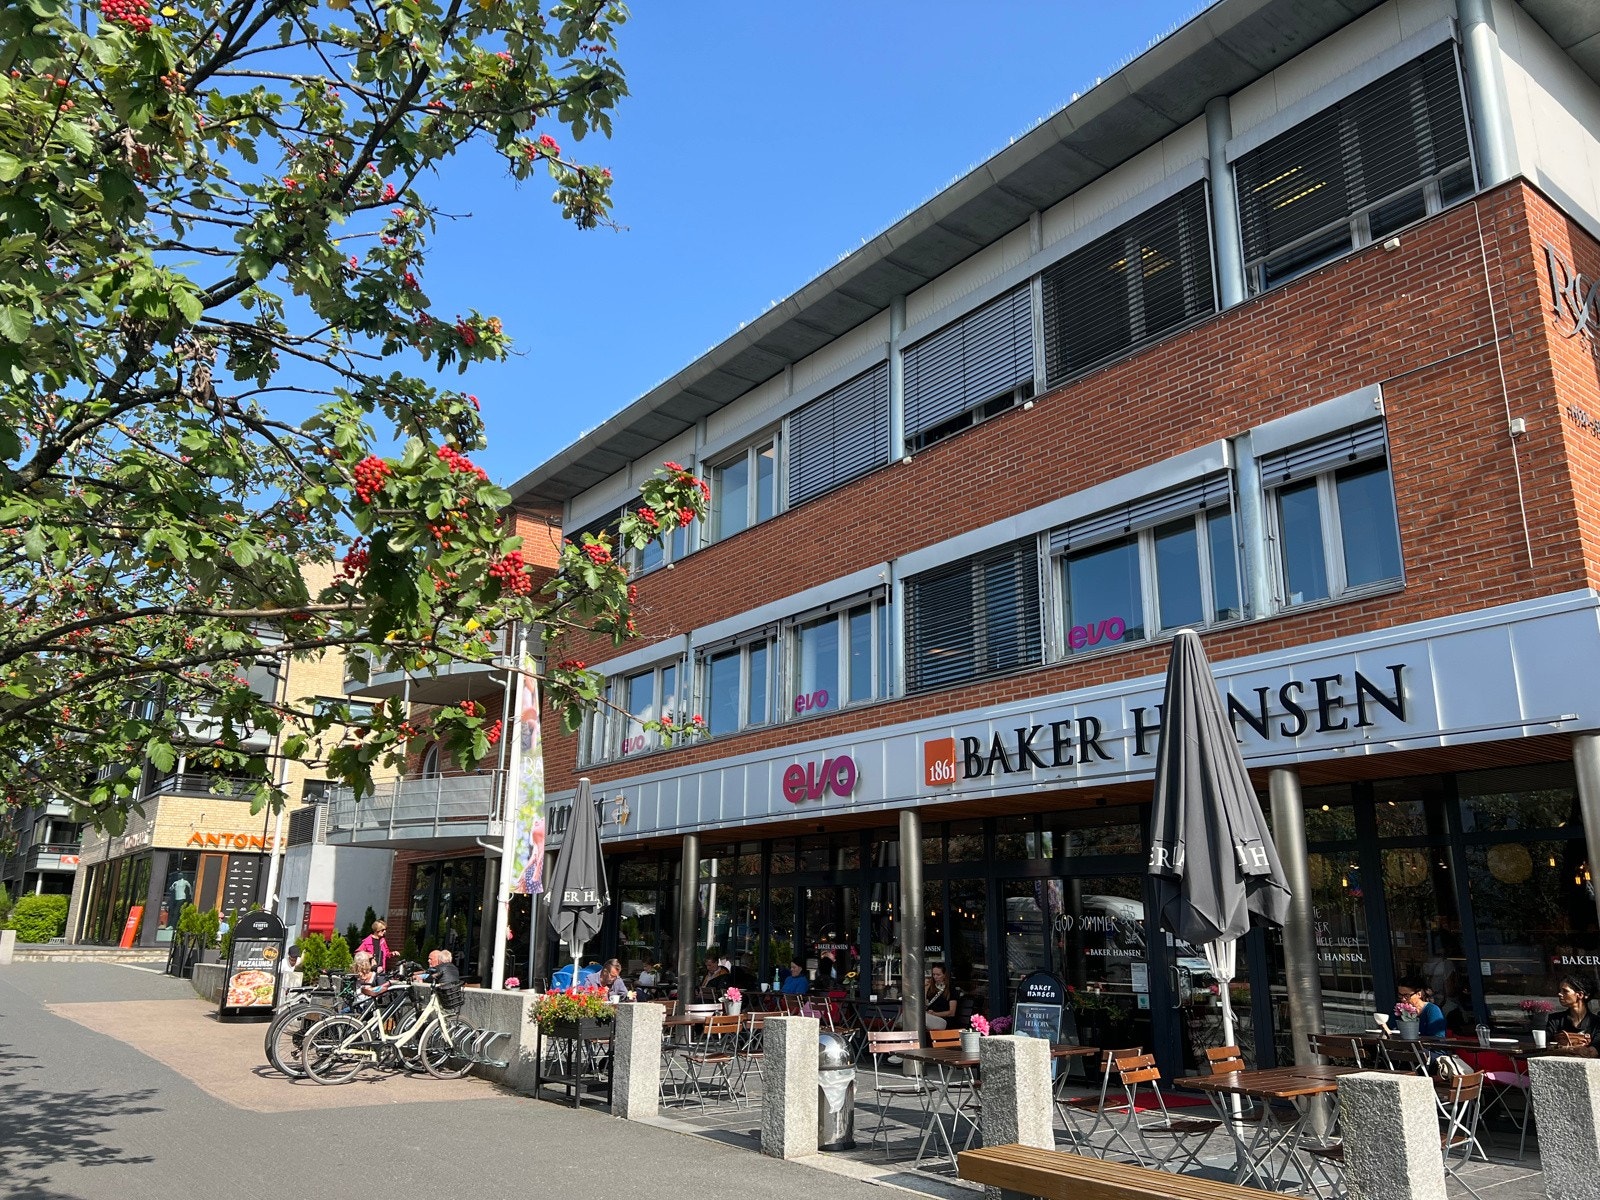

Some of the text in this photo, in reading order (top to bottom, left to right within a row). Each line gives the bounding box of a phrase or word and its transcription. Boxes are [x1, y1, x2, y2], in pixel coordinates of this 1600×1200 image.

[1068, 616, 1126, 649] evo
[794, 689, 829, 713] evo
[929, 663, 1407, 783] 1861 BAKER HNSEN
[621, 734, 645, 754] evo
[782, 755, 858, 804] evo
[1054, 913, 1121, 933] GOD SOMMER
[1112, 949, 1141, 957] HANSEN
[1324, 952, 1363, 962] HANSEN
[1561, 955, 1600, 965] BAKER
